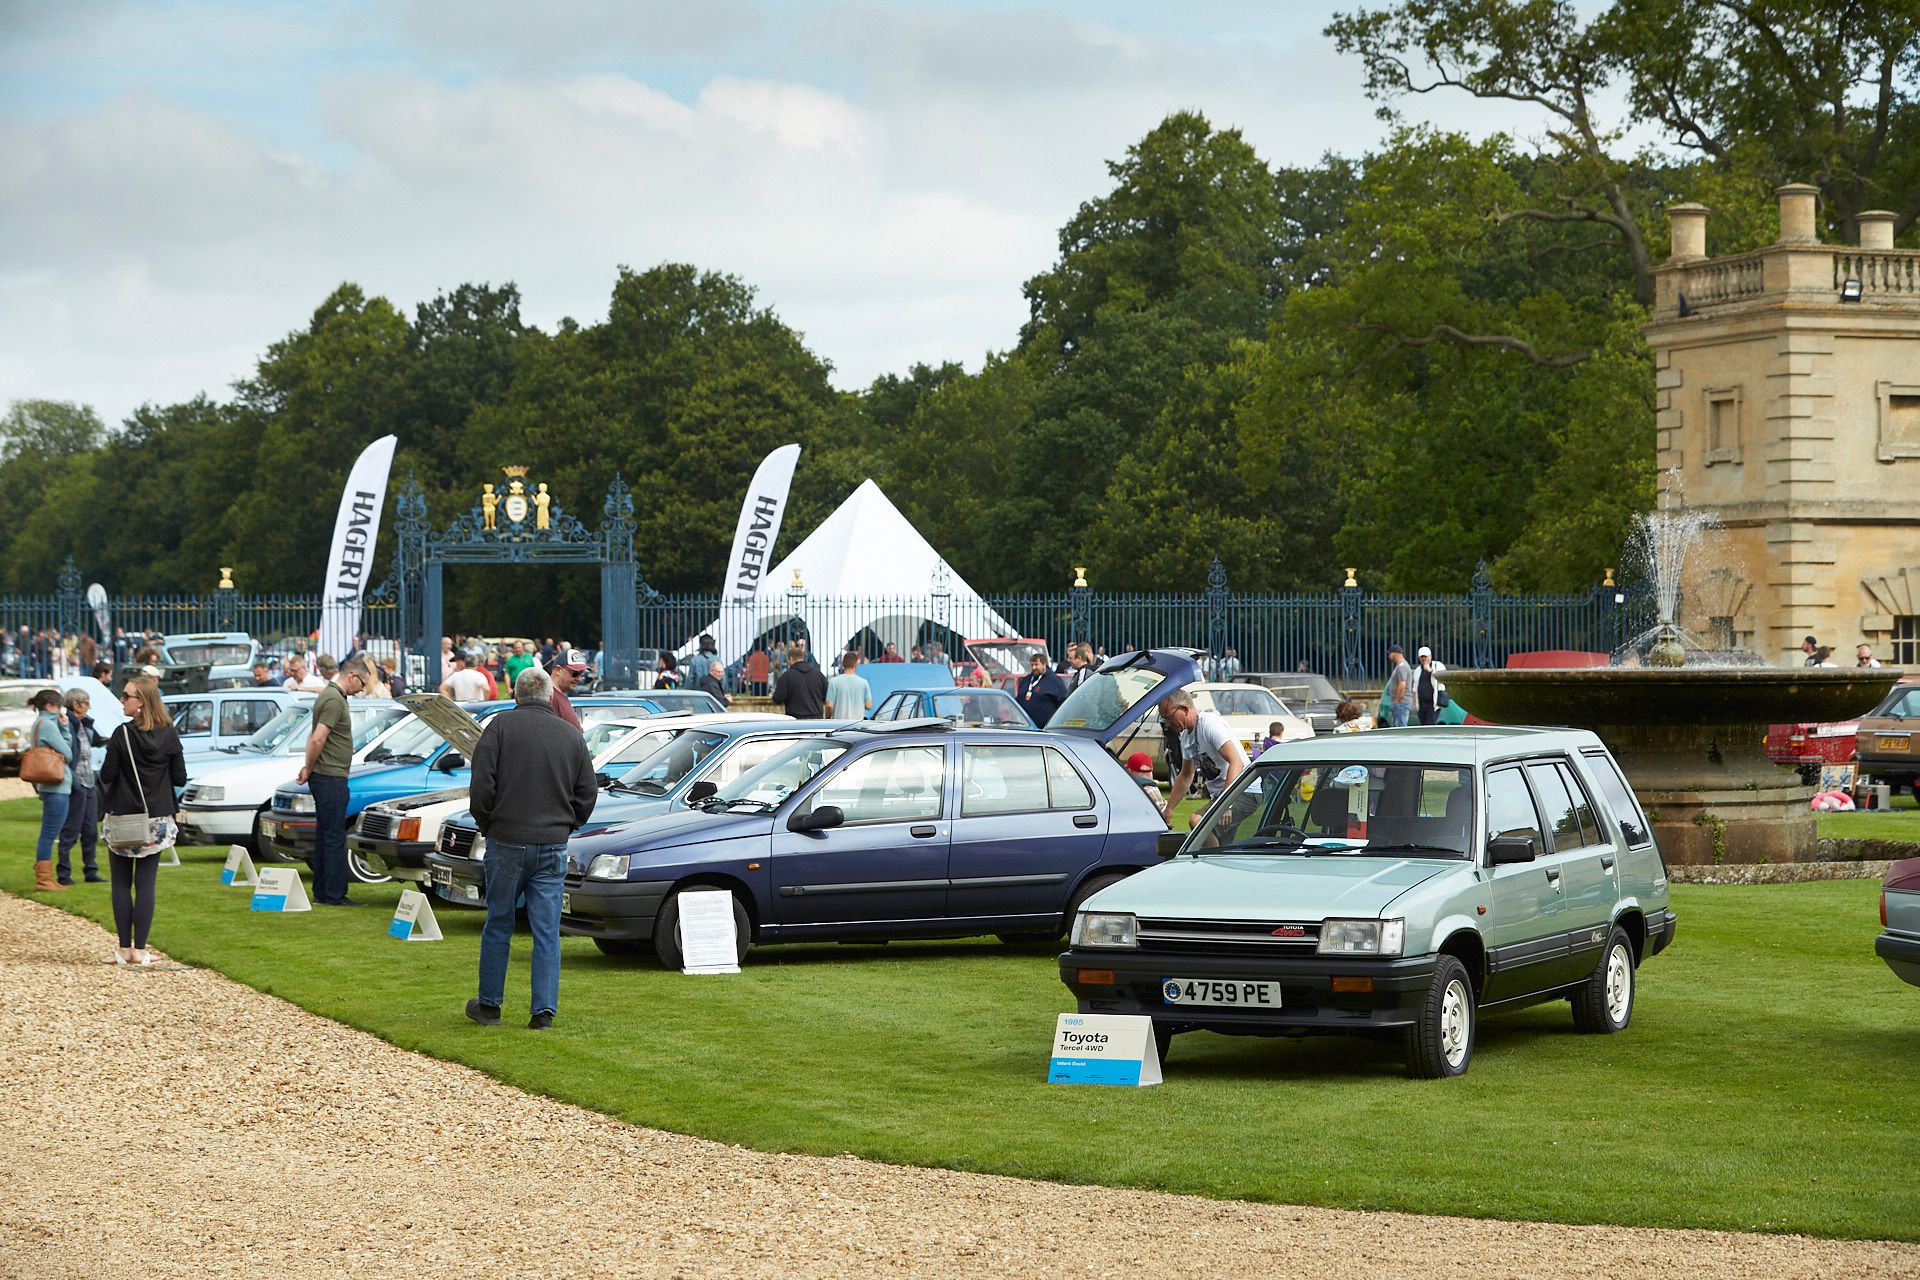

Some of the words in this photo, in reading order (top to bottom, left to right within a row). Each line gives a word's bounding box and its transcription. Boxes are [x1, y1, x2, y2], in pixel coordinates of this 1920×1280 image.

[335, 491, 376, 610] HAGERTY
[732, 495, 777, 612] HAGERTY
[1271, 927, 1306, 937] 4WD
[1184, 981, 1238, 1002] 4759
[1243, 984, 1271, 1004] PE
[1064, 1018, 1084, 1026] 1985
[1062, 1031, 1109, 1045] Toyota
